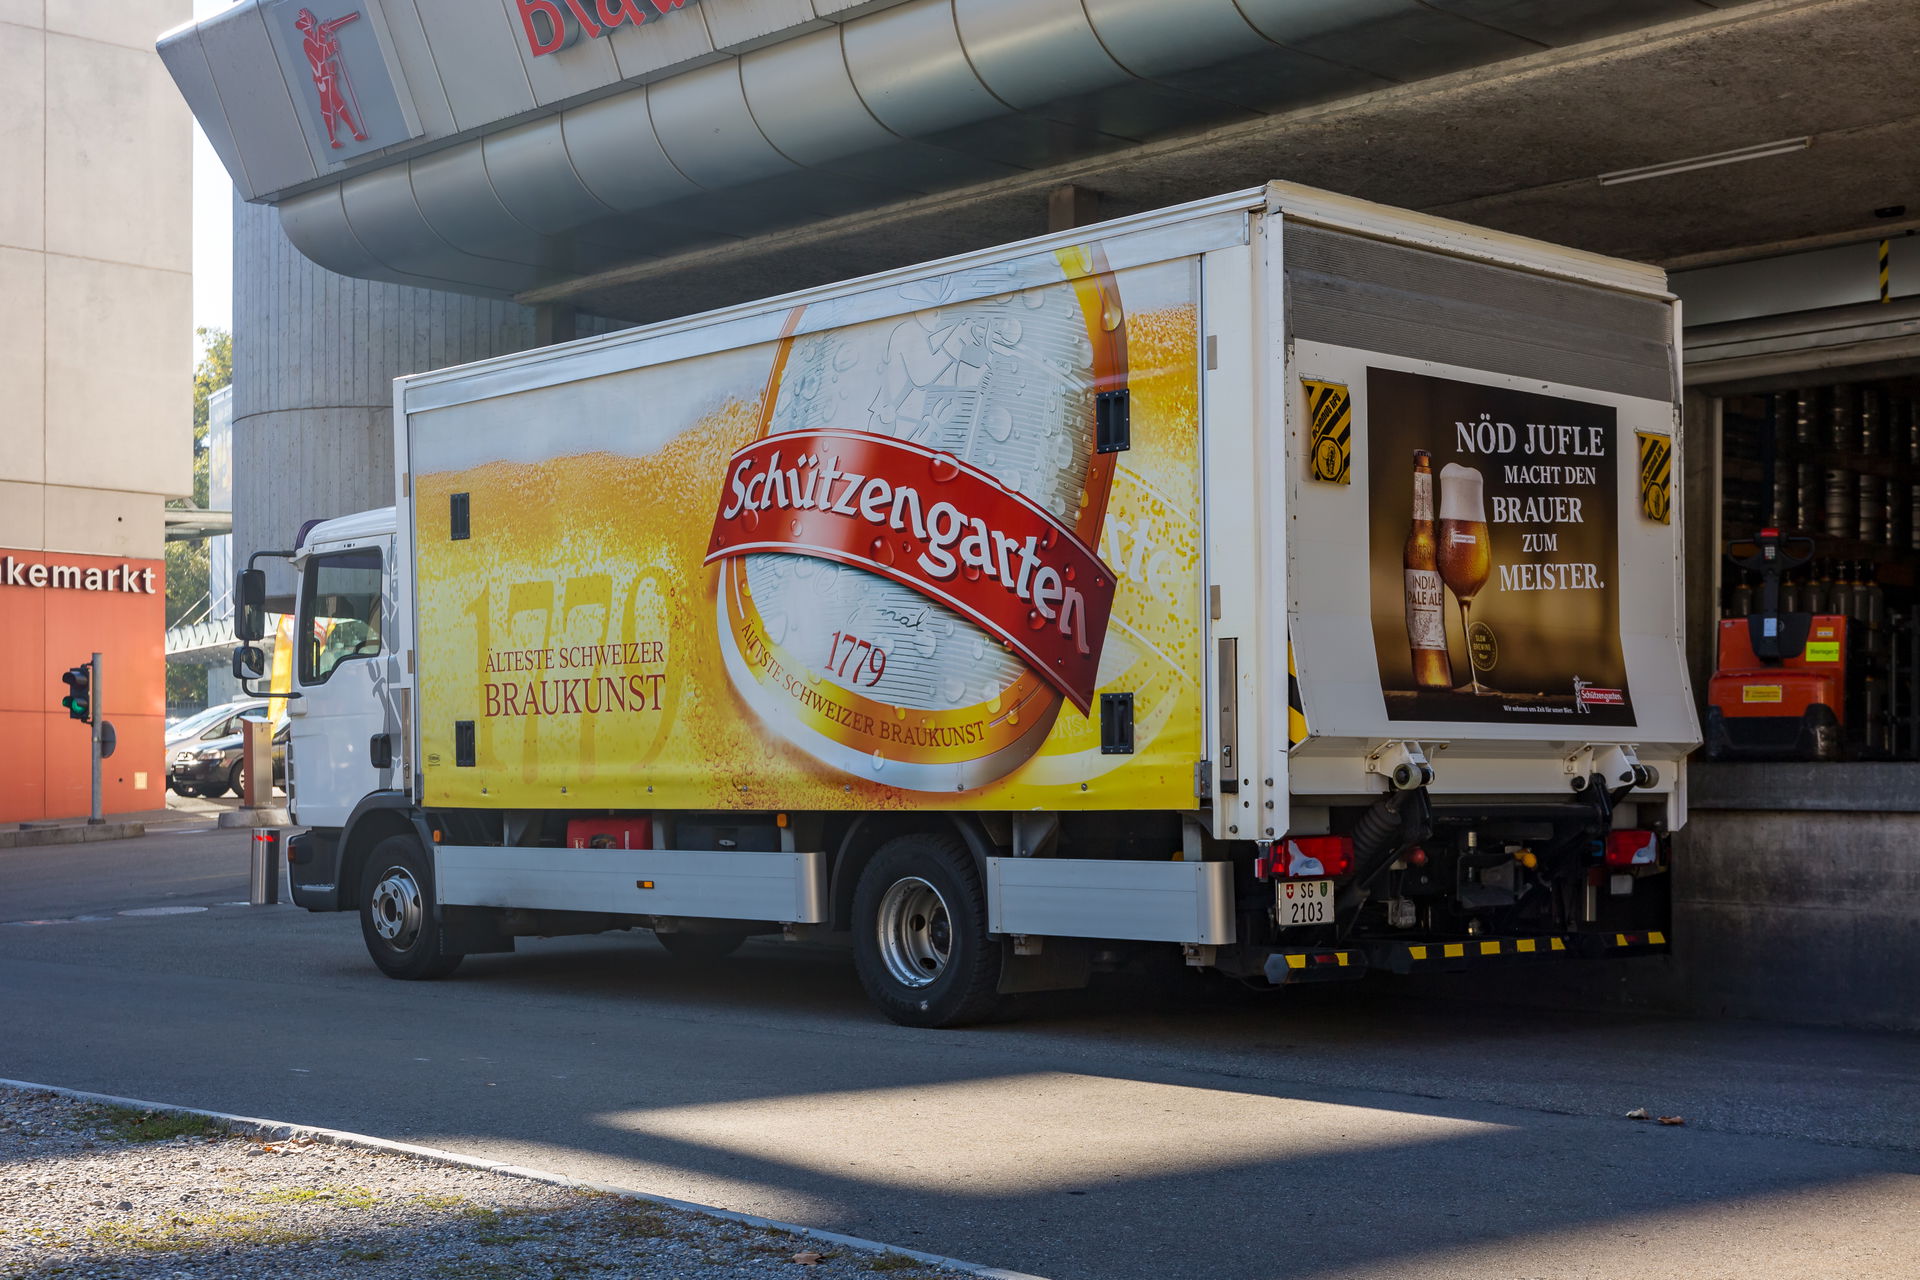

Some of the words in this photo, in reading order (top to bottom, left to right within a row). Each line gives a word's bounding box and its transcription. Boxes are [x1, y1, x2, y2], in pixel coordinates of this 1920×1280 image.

[1455, 413, 1517, 454] NÖD
[1524, 423, 1605, 457] JUFLE
[1504, 465, 1561, 484] MACHT
[1565, 466, 1596, 485] DEN
[1492, 496, 1584, 523] BRAUER
[723, 450, 1090, 655] Schützengarten
[1522, 533, 1558, 552] ZUM
[0, 556, 156, 594] kemarkt
[1412, 575, 1437, 590] INDIA
[1499, 563, 1605, 592] MEISTER.
[1407, 591, 1427, 606] PALE
[1428, 592, 1443, 607] ALE
[485, 648, 555, 673] ÄLTESTE
[559, 641, 664, 669] SCHWEIZER
[824, 630, 887, 687] 1779
[484, 674, 666, 717] BRAUKUNST
[782, 674, 875, 736] SCHWEIZER
[878, 720, 985, 748] BRAUKUNST
[1300, 883, 1314, 899] SG
[1291, 901, 1323, 924] 2103
